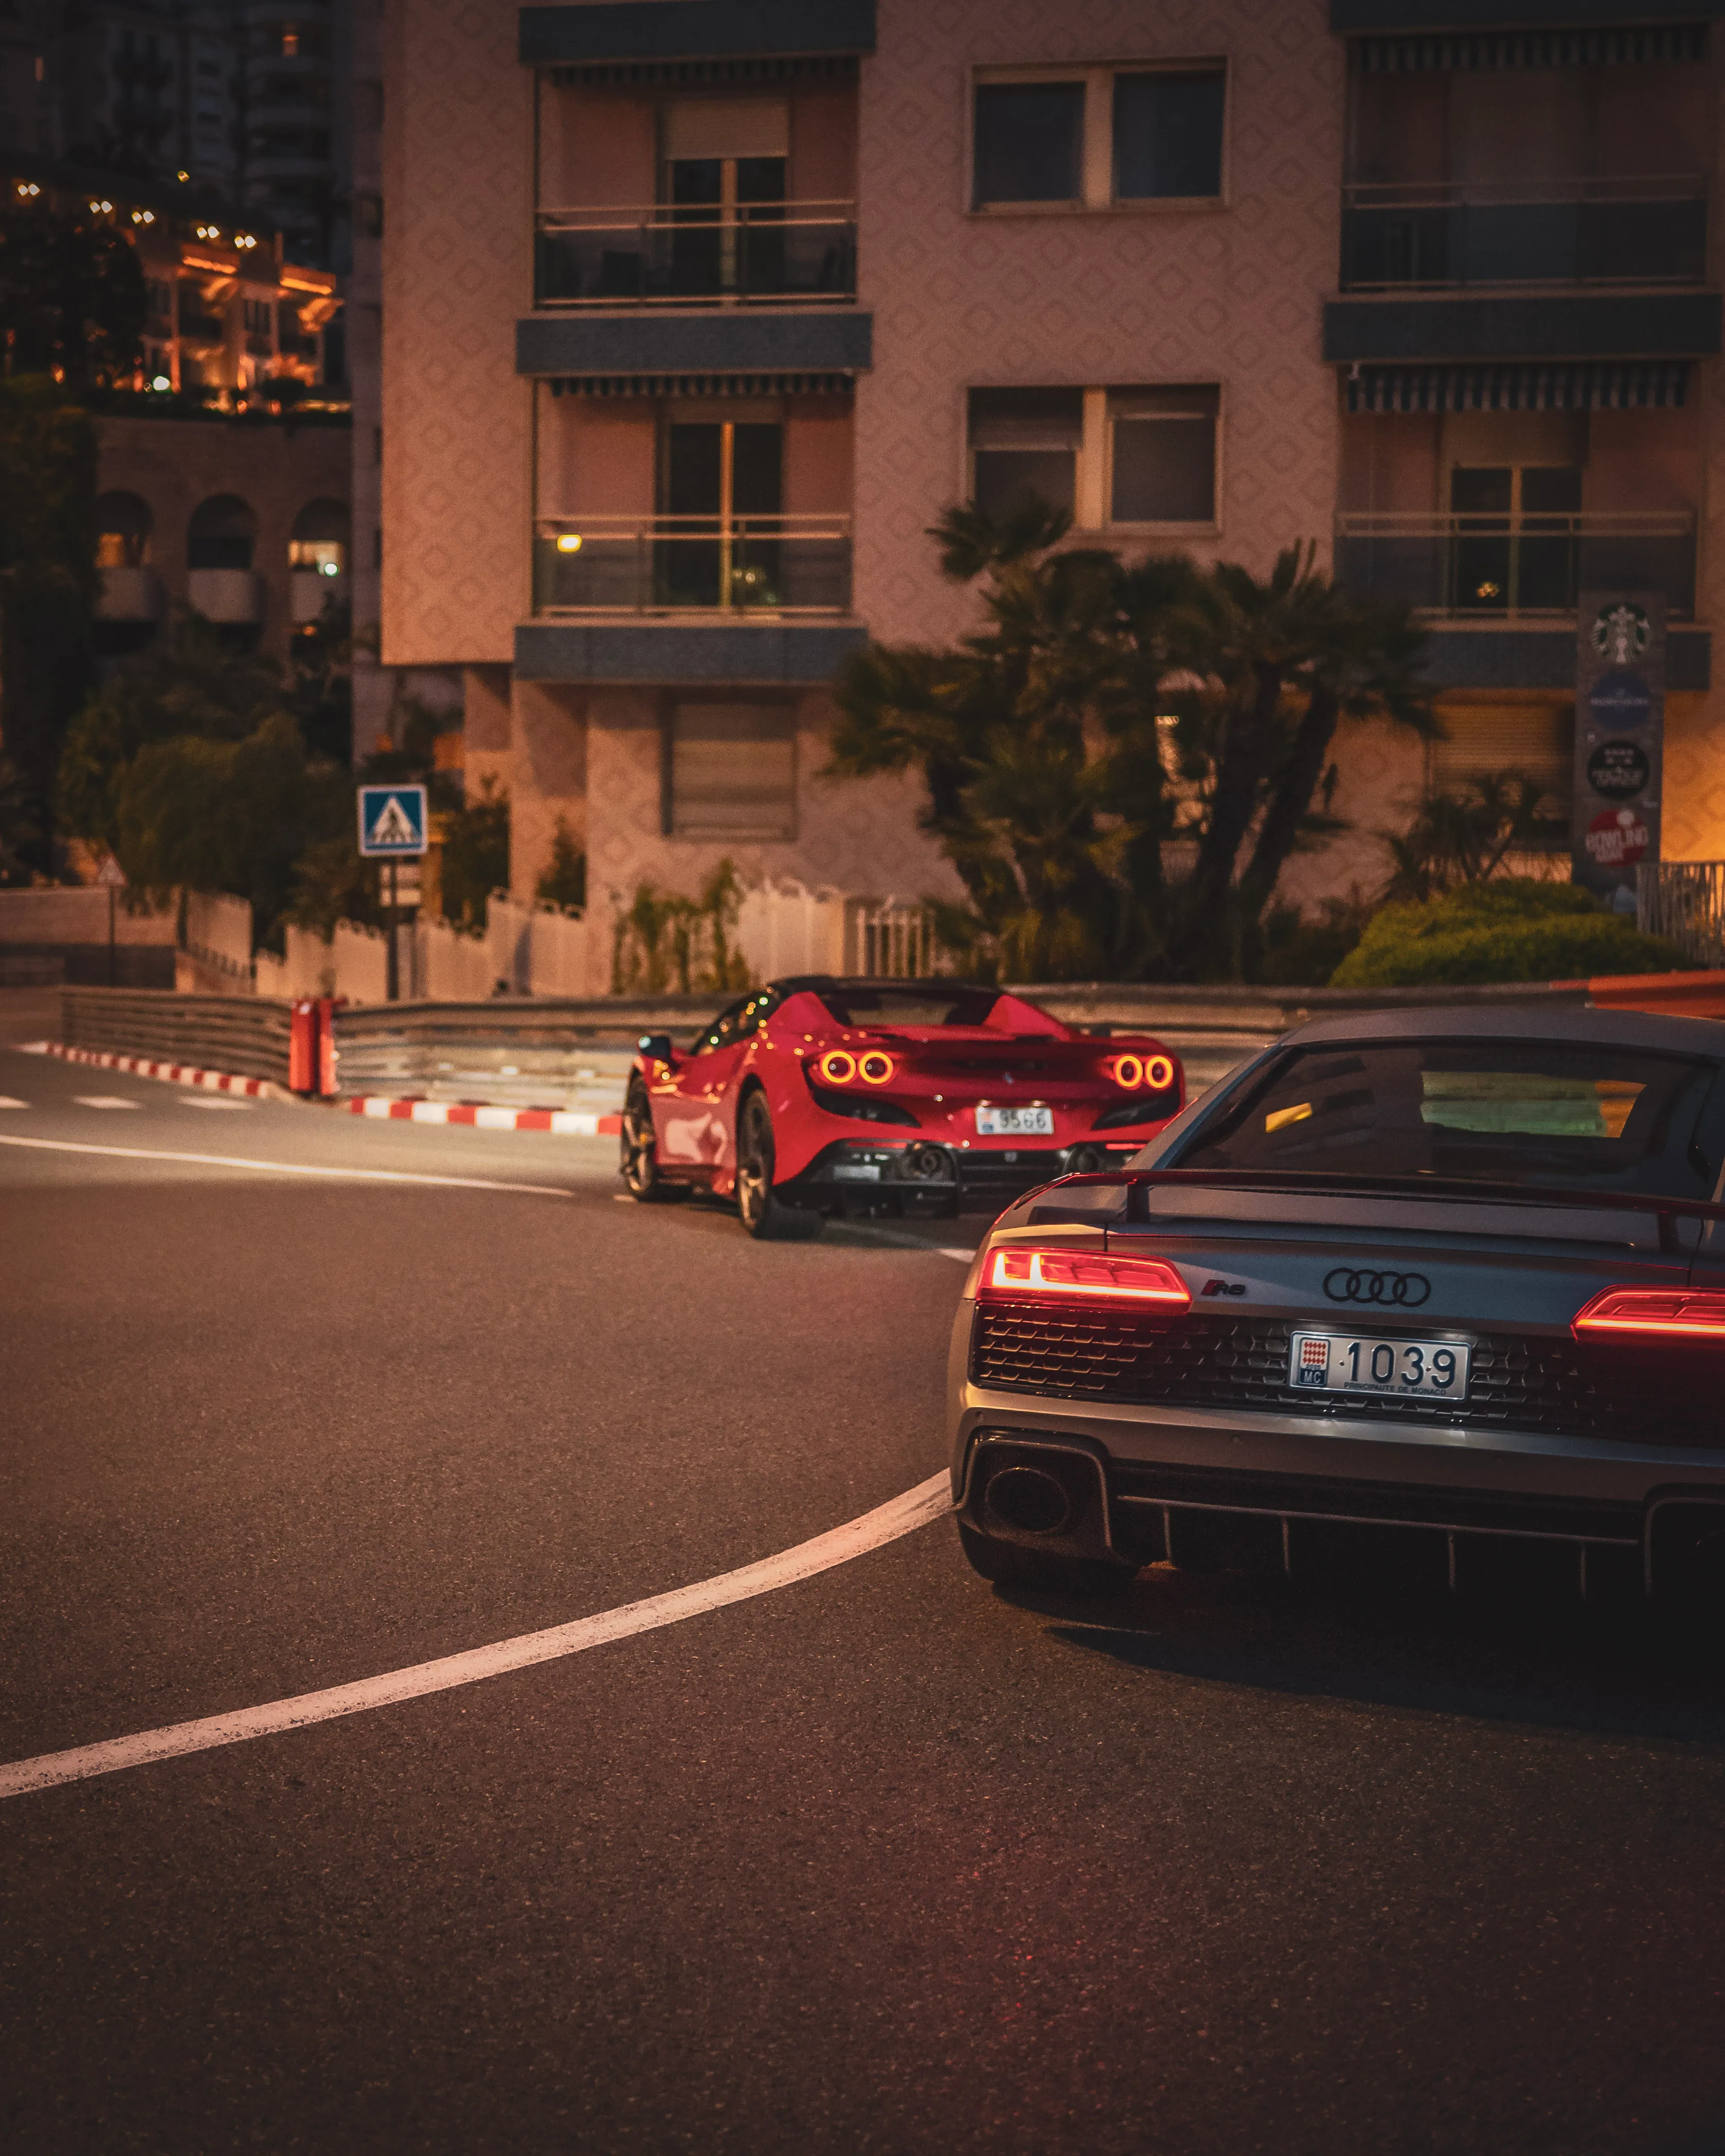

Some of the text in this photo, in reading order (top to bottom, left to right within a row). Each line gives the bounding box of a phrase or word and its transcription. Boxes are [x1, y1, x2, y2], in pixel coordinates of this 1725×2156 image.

[1201, 1280, 1246, 1296] R8
[1348, 1342, 1456, 1388] 1039
[1304, 1370, 1322, 1384] MC
[1411, 1387, 1447, 1396] MONACO
